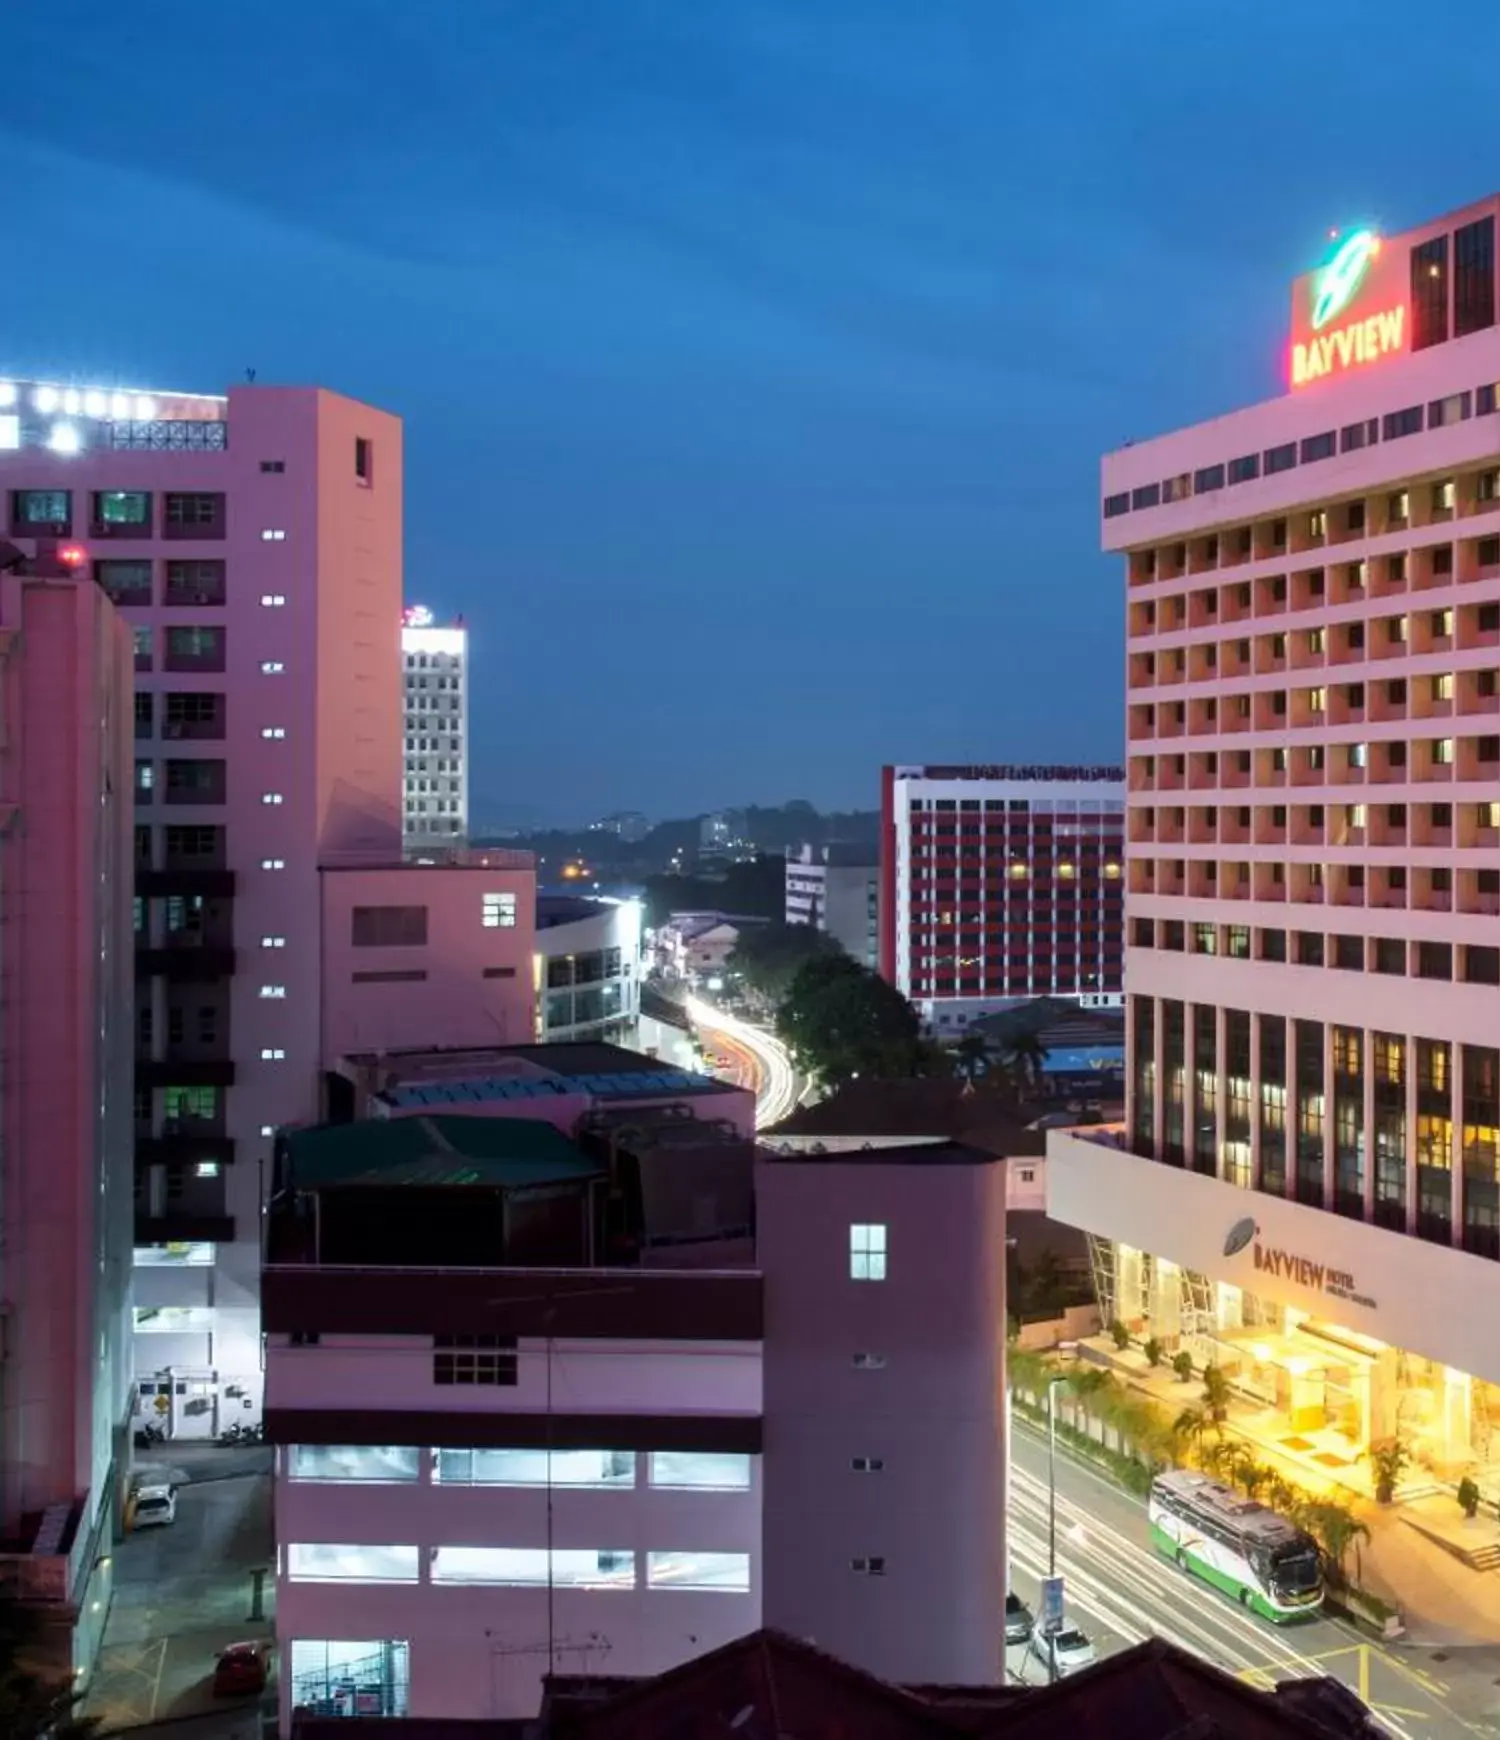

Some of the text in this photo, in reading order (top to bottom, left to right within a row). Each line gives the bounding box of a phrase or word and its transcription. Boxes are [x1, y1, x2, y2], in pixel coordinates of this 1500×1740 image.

[1292, 304, 1404, 384] BAYVIEW
[1253, 1242, 1355, 1291] BAYVIEW HOTEL
